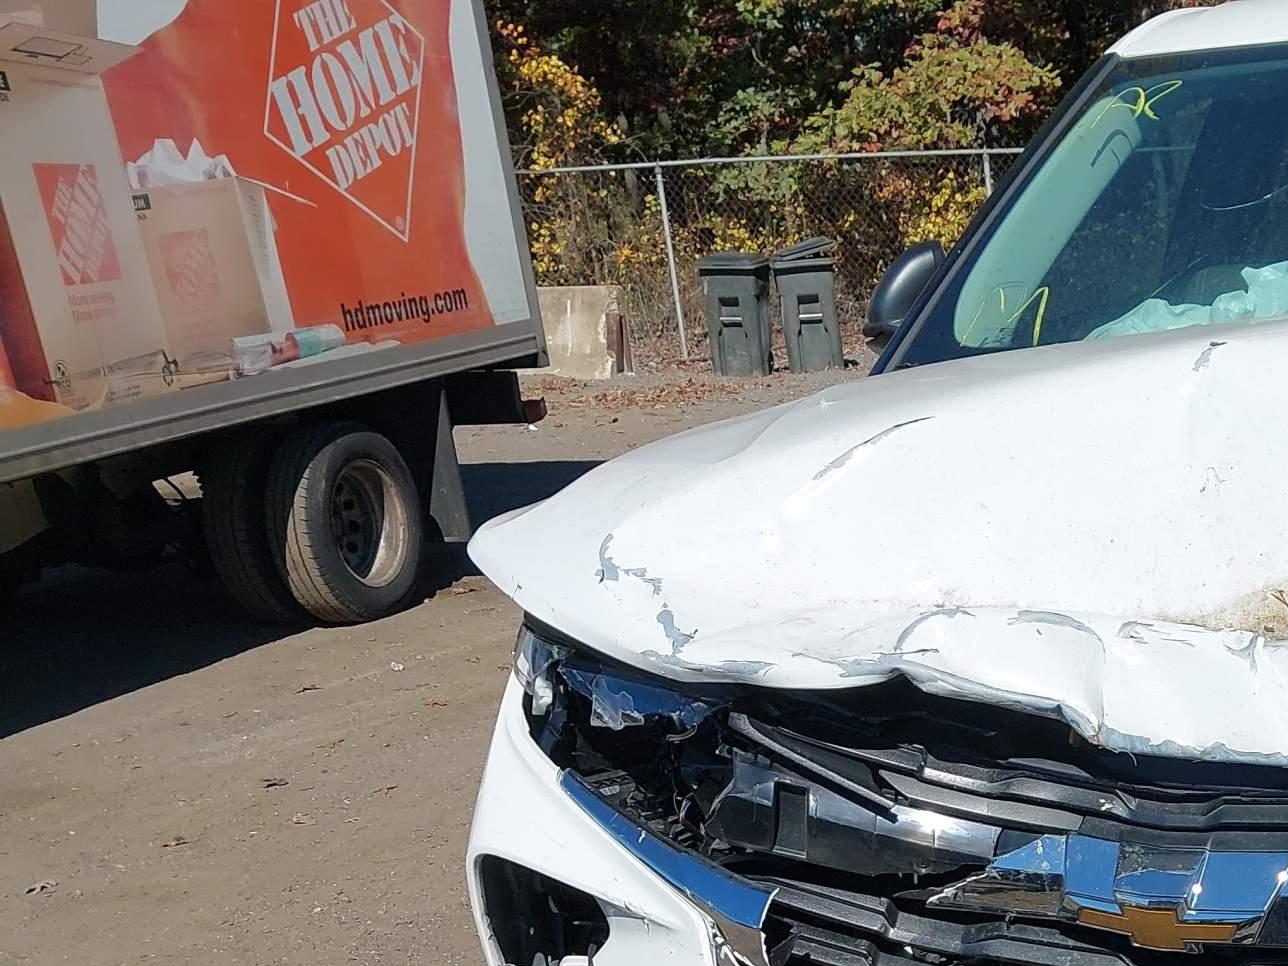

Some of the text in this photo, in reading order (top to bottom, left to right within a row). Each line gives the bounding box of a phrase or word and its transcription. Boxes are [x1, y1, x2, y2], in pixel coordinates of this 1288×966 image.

[293, 0, 357, 52] THE
[270, 13, 420, 157] HOME
[325, 102, 413, 191] DEPOT
[341, 287, 469, 332] hdmoving.com
